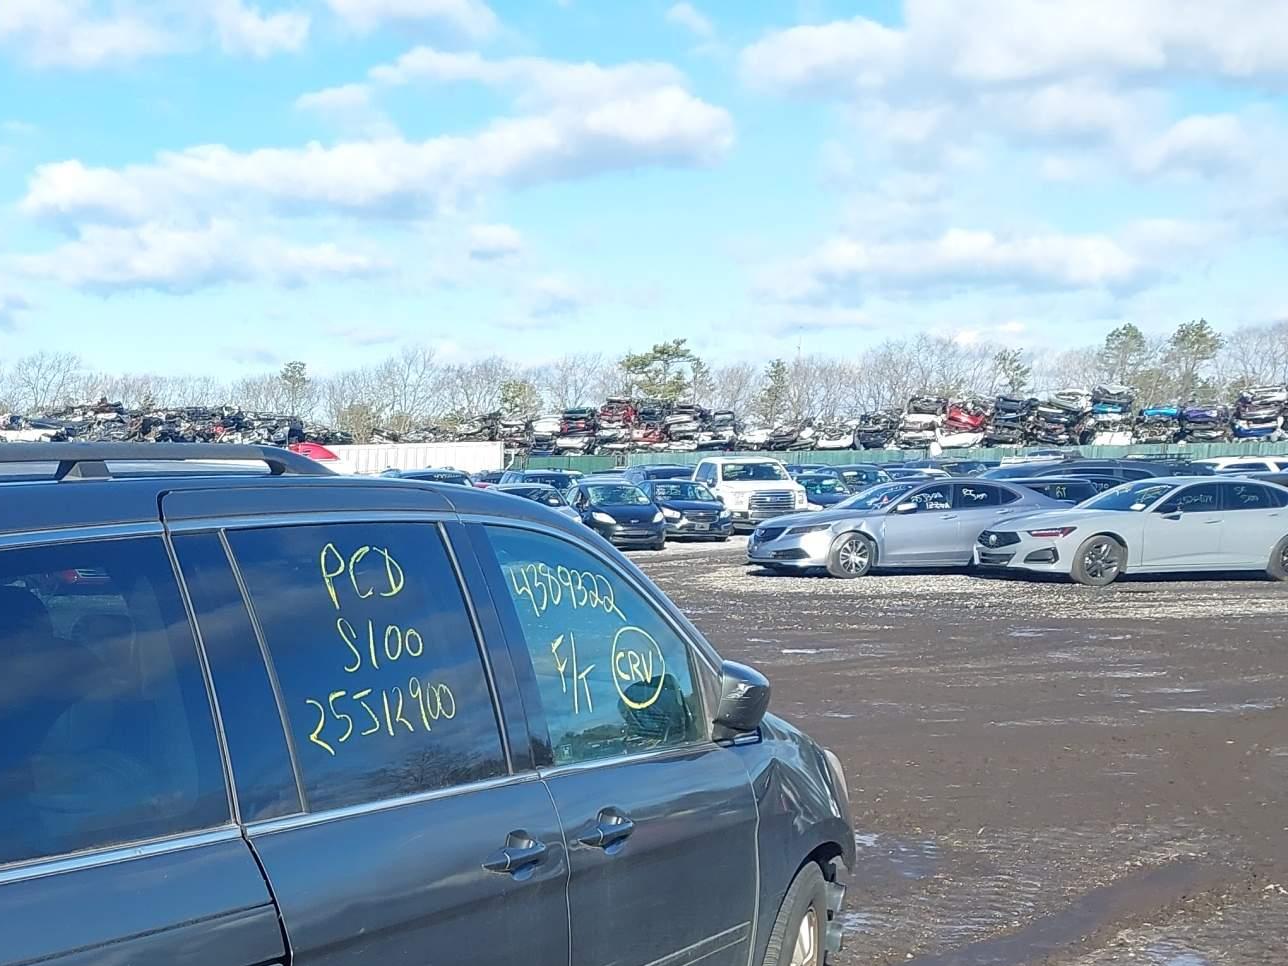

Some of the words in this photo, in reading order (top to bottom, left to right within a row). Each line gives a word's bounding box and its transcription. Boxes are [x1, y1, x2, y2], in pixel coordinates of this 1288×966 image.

[320, 542, 404, 609] PCD
[509, 563, 627, 622] 4389322
[337, 617, 423, 672] S100
[615, 650, 652, 684] CRV
